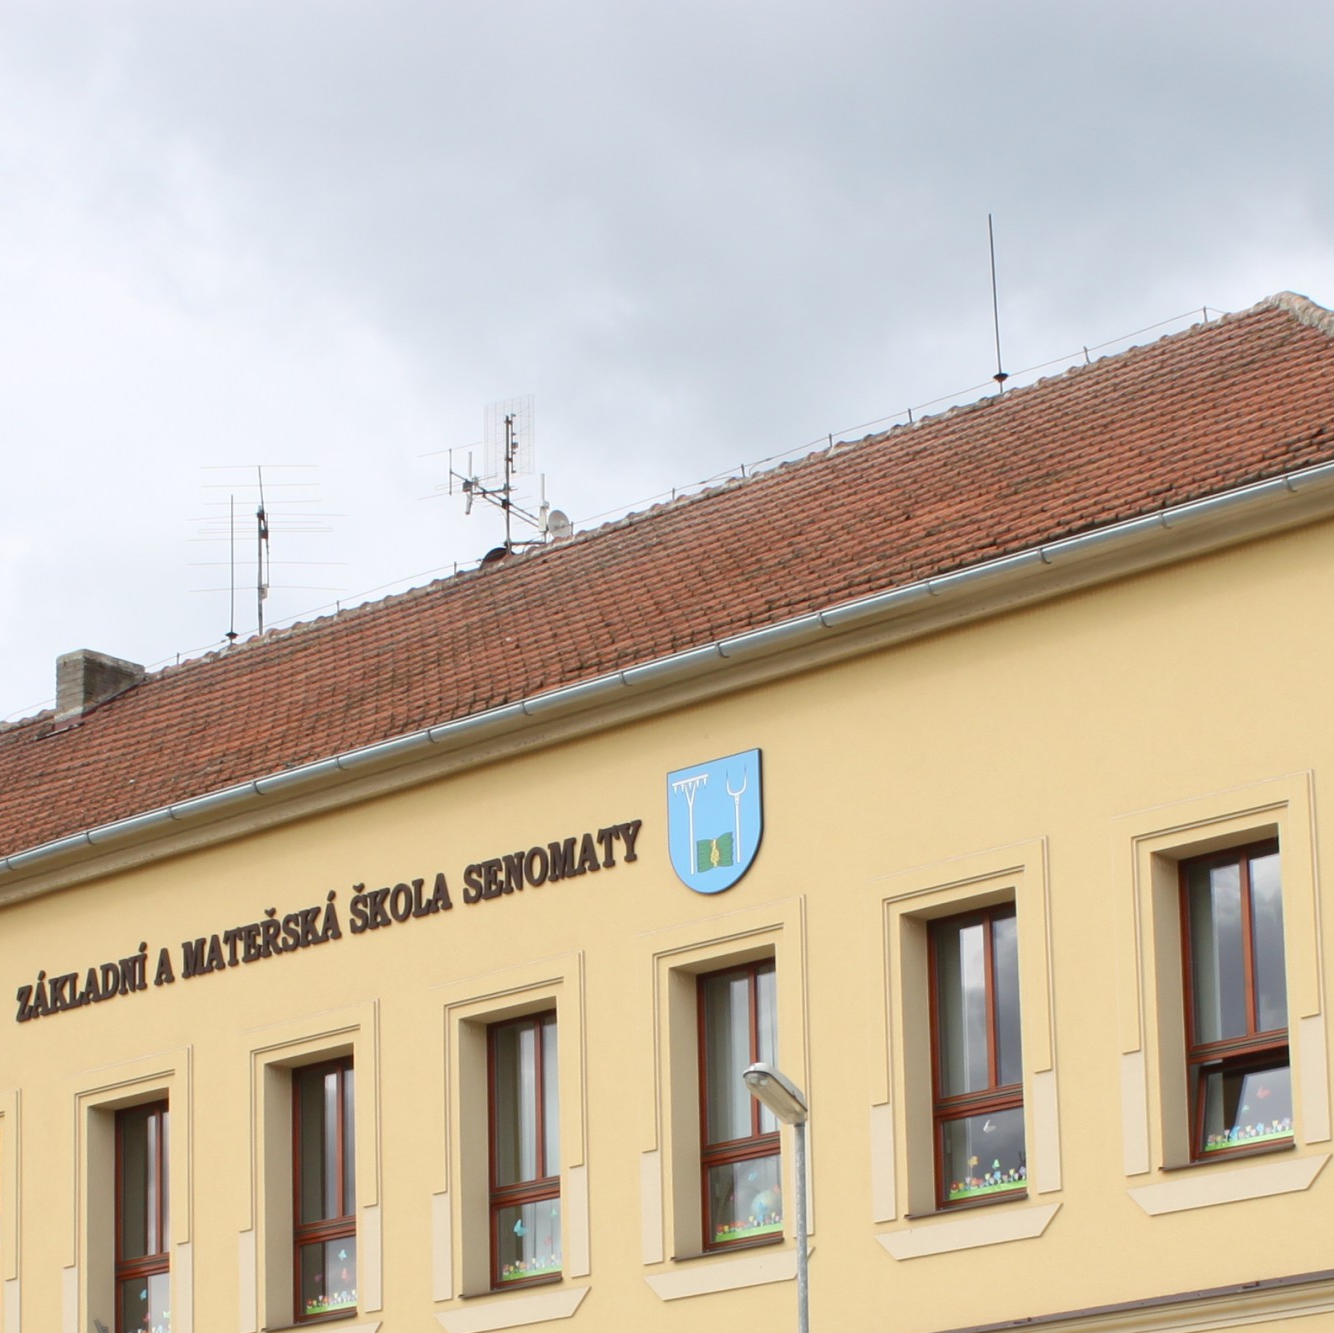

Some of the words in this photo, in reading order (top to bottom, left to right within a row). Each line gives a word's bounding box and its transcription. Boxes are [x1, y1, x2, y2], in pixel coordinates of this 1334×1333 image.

[15, 942, 148, 1023] ZÁKLADNÍ
[154, 948, 176, 986] A
[181, 891, 343, 979] MATEŘSKÁ
[349, 872, 453, 934] ŠKOLA
[462, 820, 643, 904] SENOMATY
